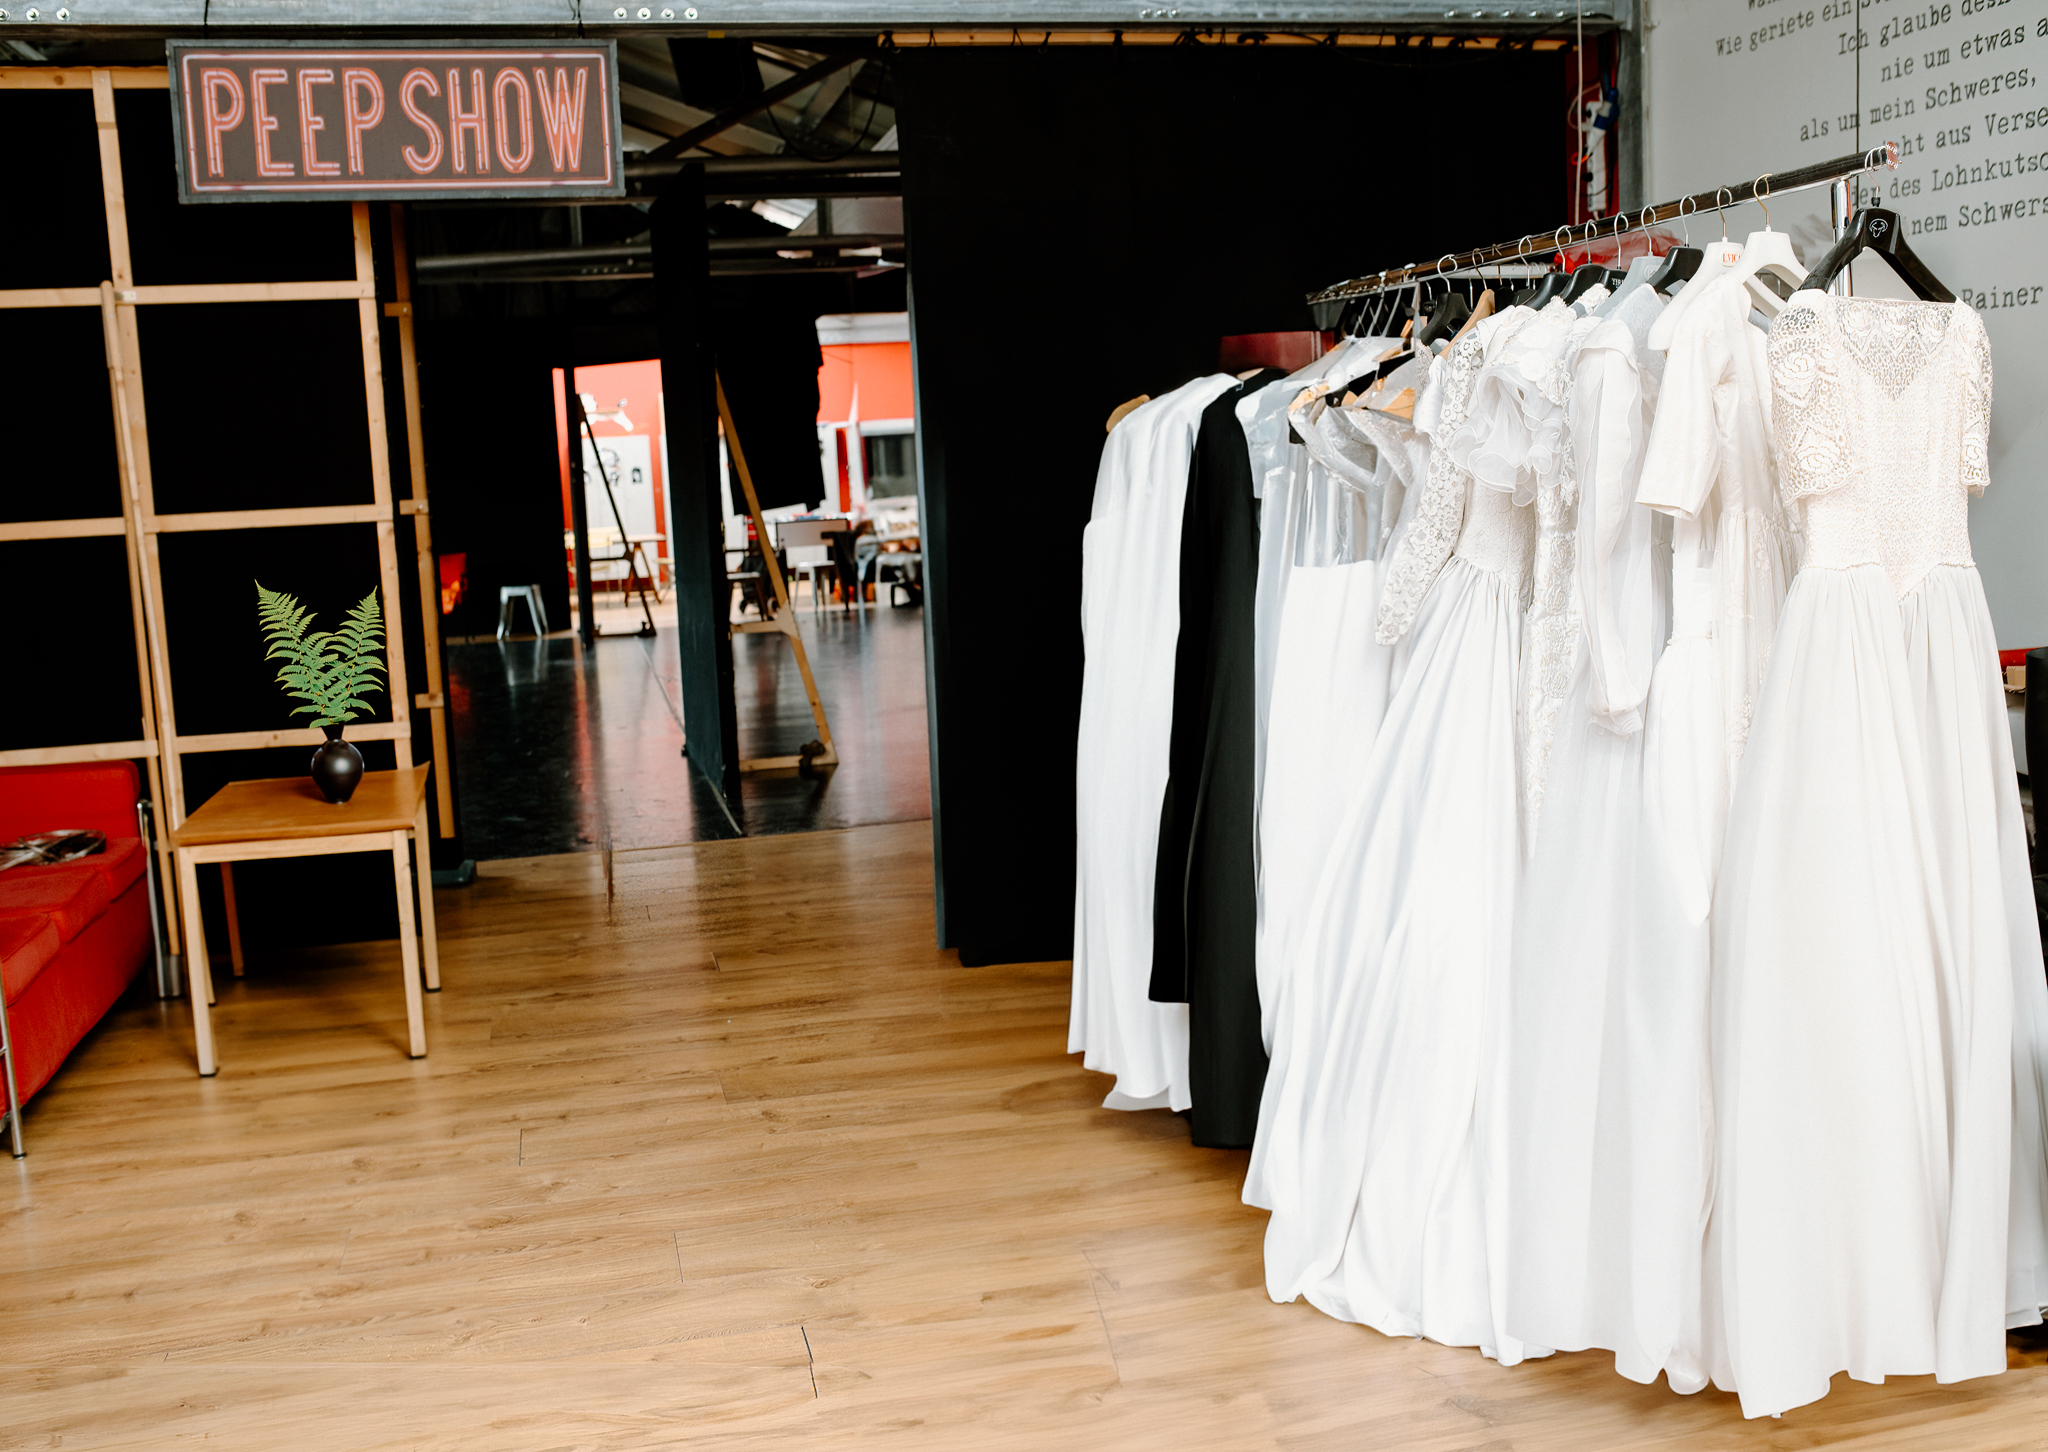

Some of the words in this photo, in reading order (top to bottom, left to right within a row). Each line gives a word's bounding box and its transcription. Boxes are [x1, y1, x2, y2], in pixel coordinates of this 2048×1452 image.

[1716, 36, 1742, 56] Wie
[1750, 10, 1814, 51] geriete
[1822, 0, 1852, 22] ein
[1838, 28, 1869, 55] Ich
[1880, 4, 1951, 47] glaube
[1881, 57, 1914, 82] nie
[1923, 47, 1951, 70] um
[1960, 25, 2025, 59] etwas
[201, 68, 384, 176] PEEP
[400, 67, 588, 174] SHOW
[1800, 118, 1829, 142] als
[1870, 97, 1916, 125] mein
[1925, 67, 2037, 110] Schweres,
[1936, 124, 1971, 149] aus
[1985, 106, 2048, 137] Verse
[1889, 177, 1921, 199] des
[1961, 285, 2044, 310] Rainer
